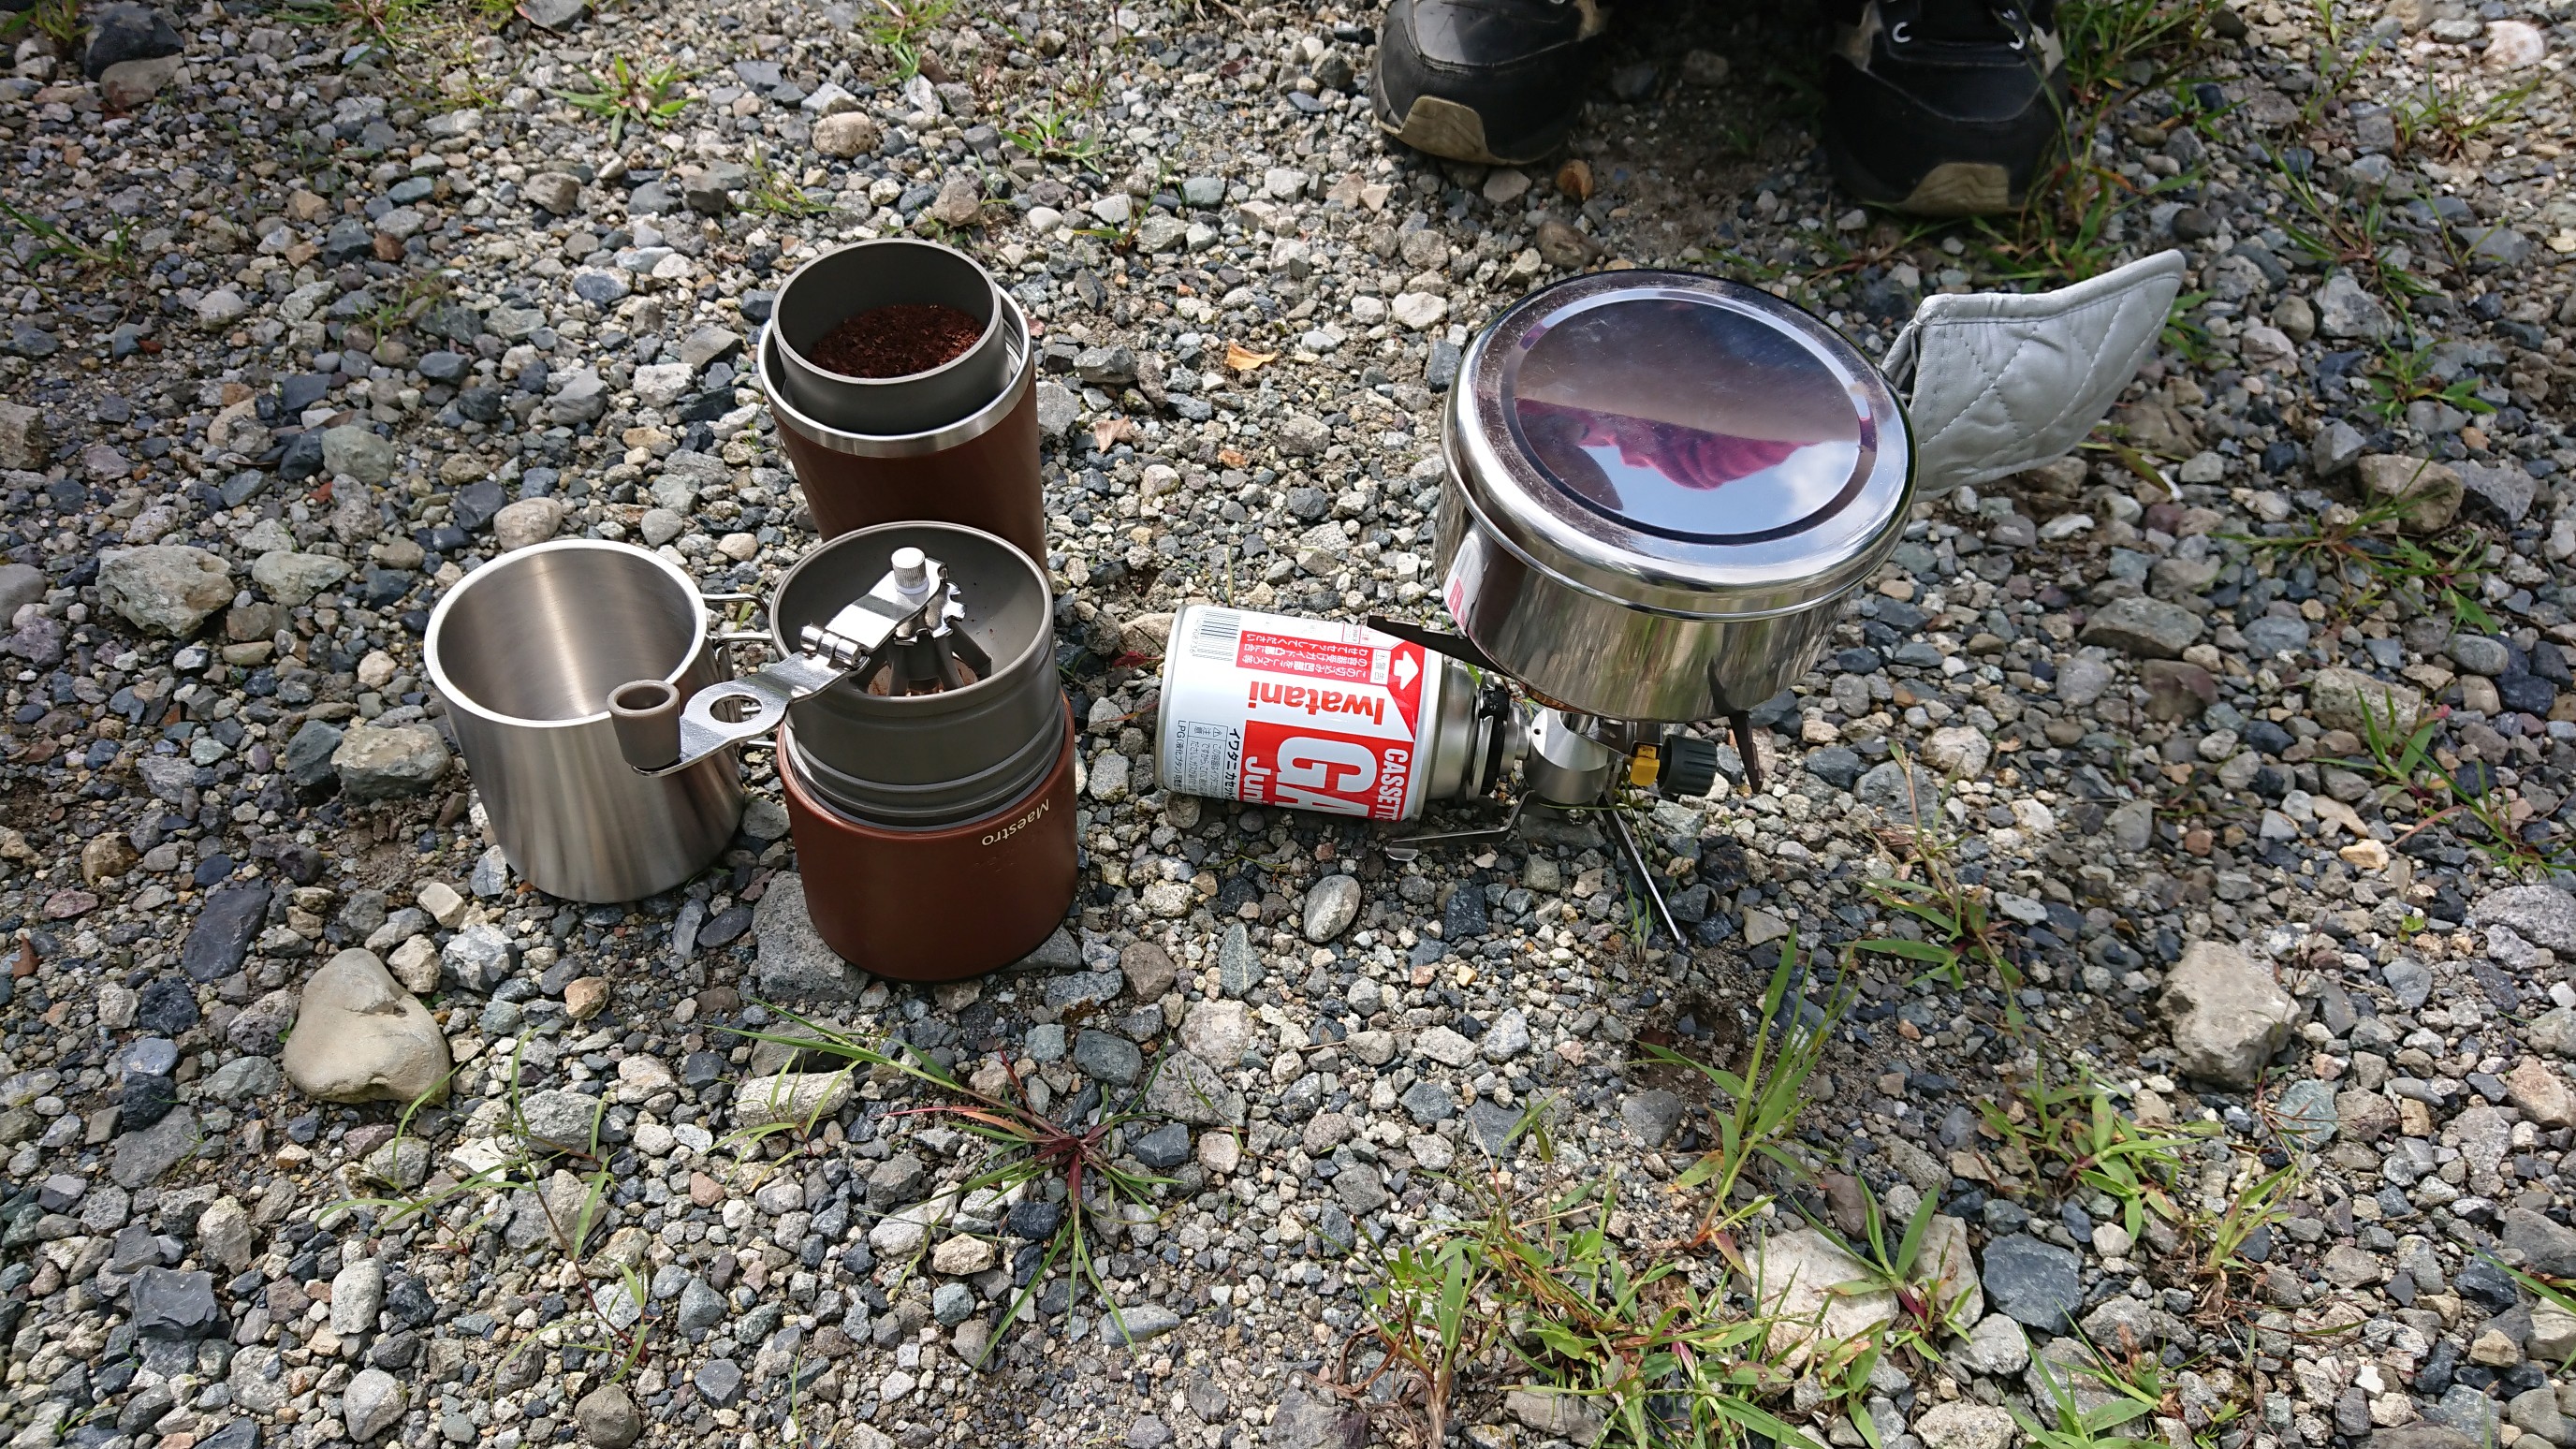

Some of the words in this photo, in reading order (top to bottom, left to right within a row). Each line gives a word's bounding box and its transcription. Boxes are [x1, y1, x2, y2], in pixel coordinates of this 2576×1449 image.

[1246, 634, 1369, 656] わせてセットしてください
[1373, 662, 1386, 681] 警告
[1248, 681, 1385, 726] Iwatani
[1193, 725, 1212, 736] 注意
[1243, 755, 1272, 805] Juni
[1375, 748, 1410, 822] CASSETTE
[981, 798, 1049, 846] Maestro
